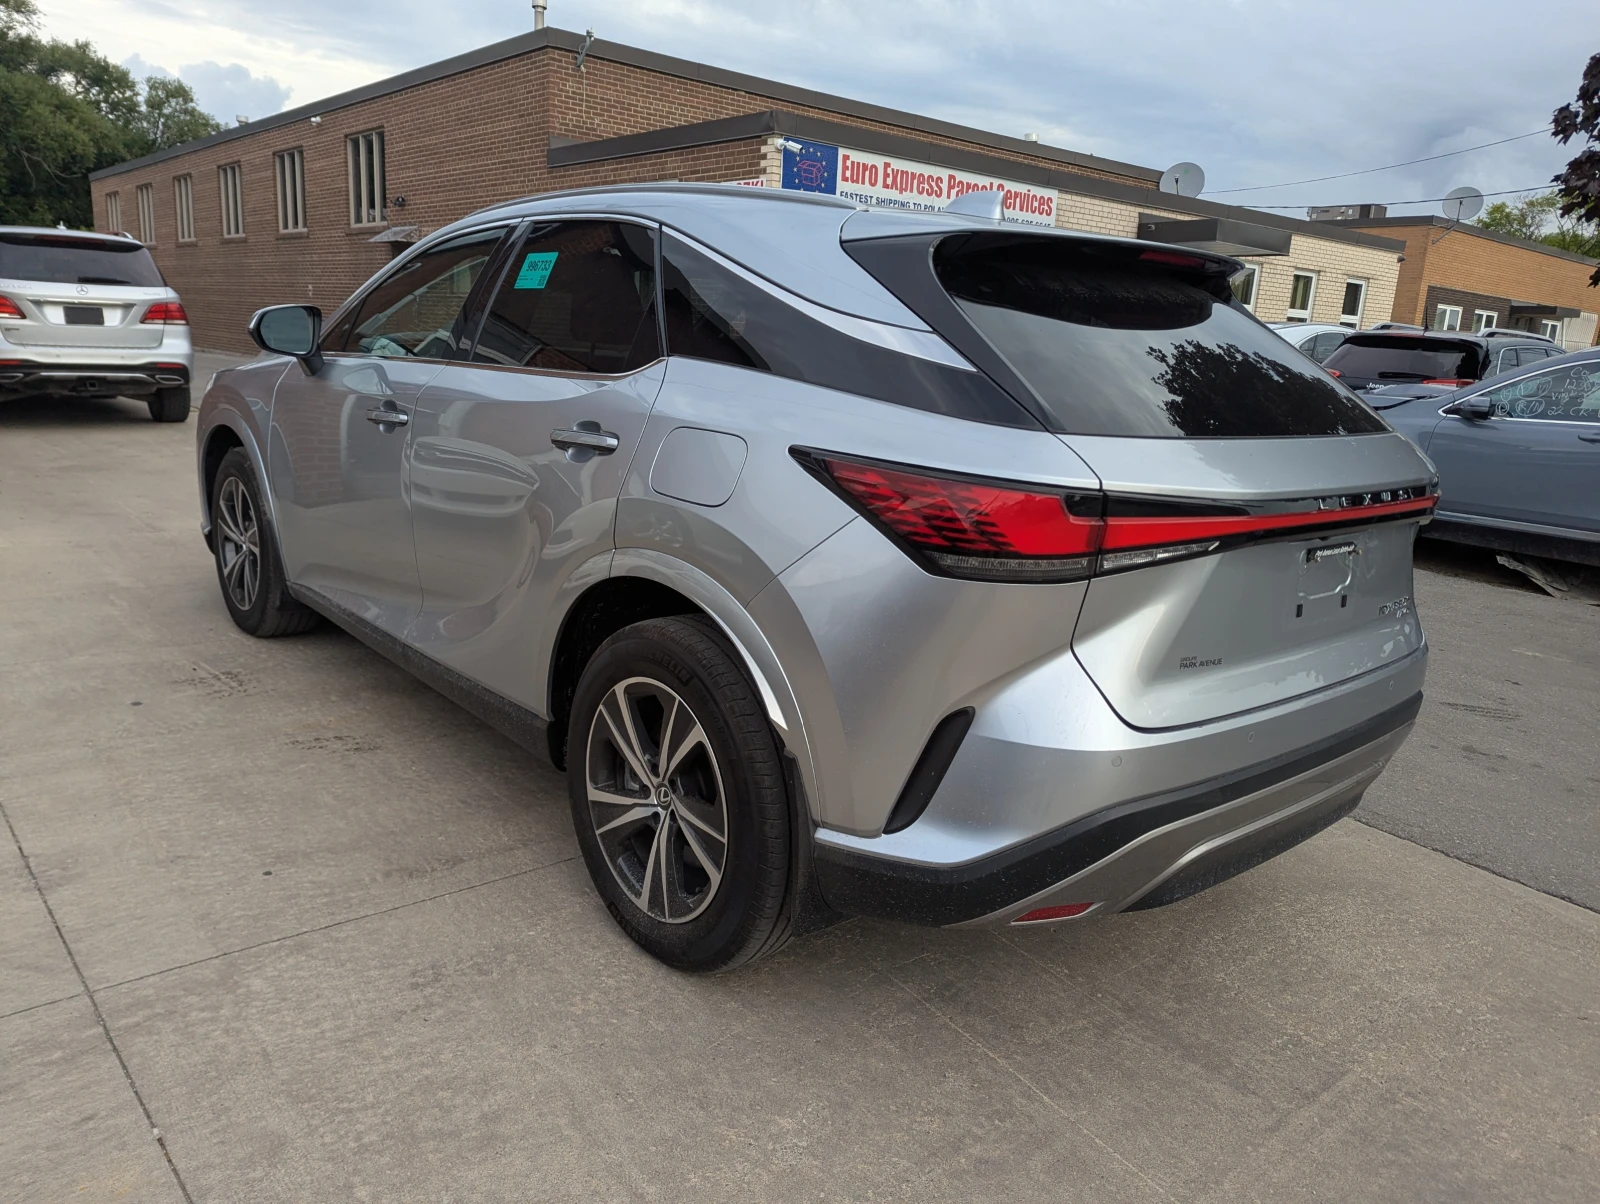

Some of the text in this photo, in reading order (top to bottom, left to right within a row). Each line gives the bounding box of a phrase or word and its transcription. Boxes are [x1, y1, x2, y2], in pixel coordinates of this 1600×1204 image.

[841, 154, 879, 187] Euro
[882, 162, 943, 198] Express
[840, 190, 874, 204] FASTEST
[876, 196, 911, 209] SHIPPING
[1180, 658, 1222, 669] PARK AVENUE
